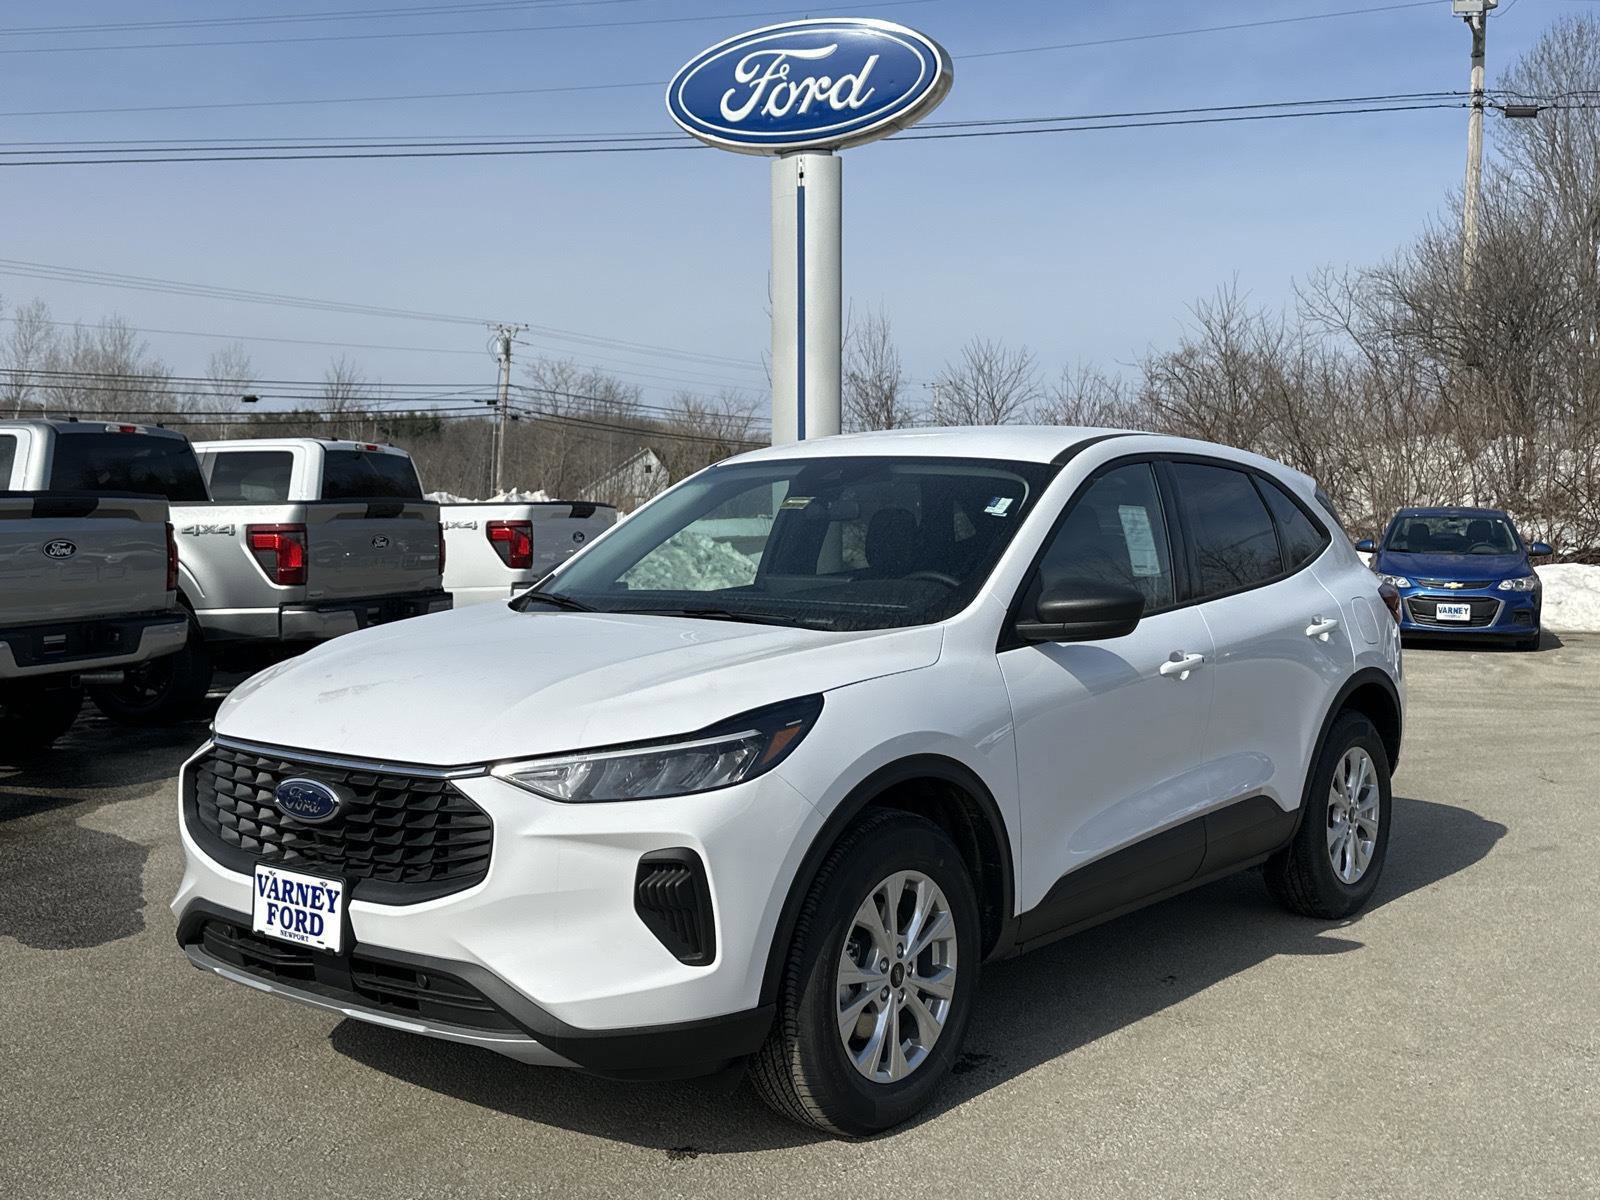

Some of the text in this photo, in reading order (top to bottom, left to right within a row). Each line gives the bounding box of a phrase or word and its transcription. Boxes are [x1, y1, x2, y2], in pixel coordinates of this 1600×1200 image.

[720, 43, 879, 122] Ford
[50, 543, 72, 555] Ford
[286, 787, 320, 812] Ford
[257, 873, 340, 913] VARNEY
[266, 902, 324, 936] FORD
[280, 929, 309, 942] NEWPORT
